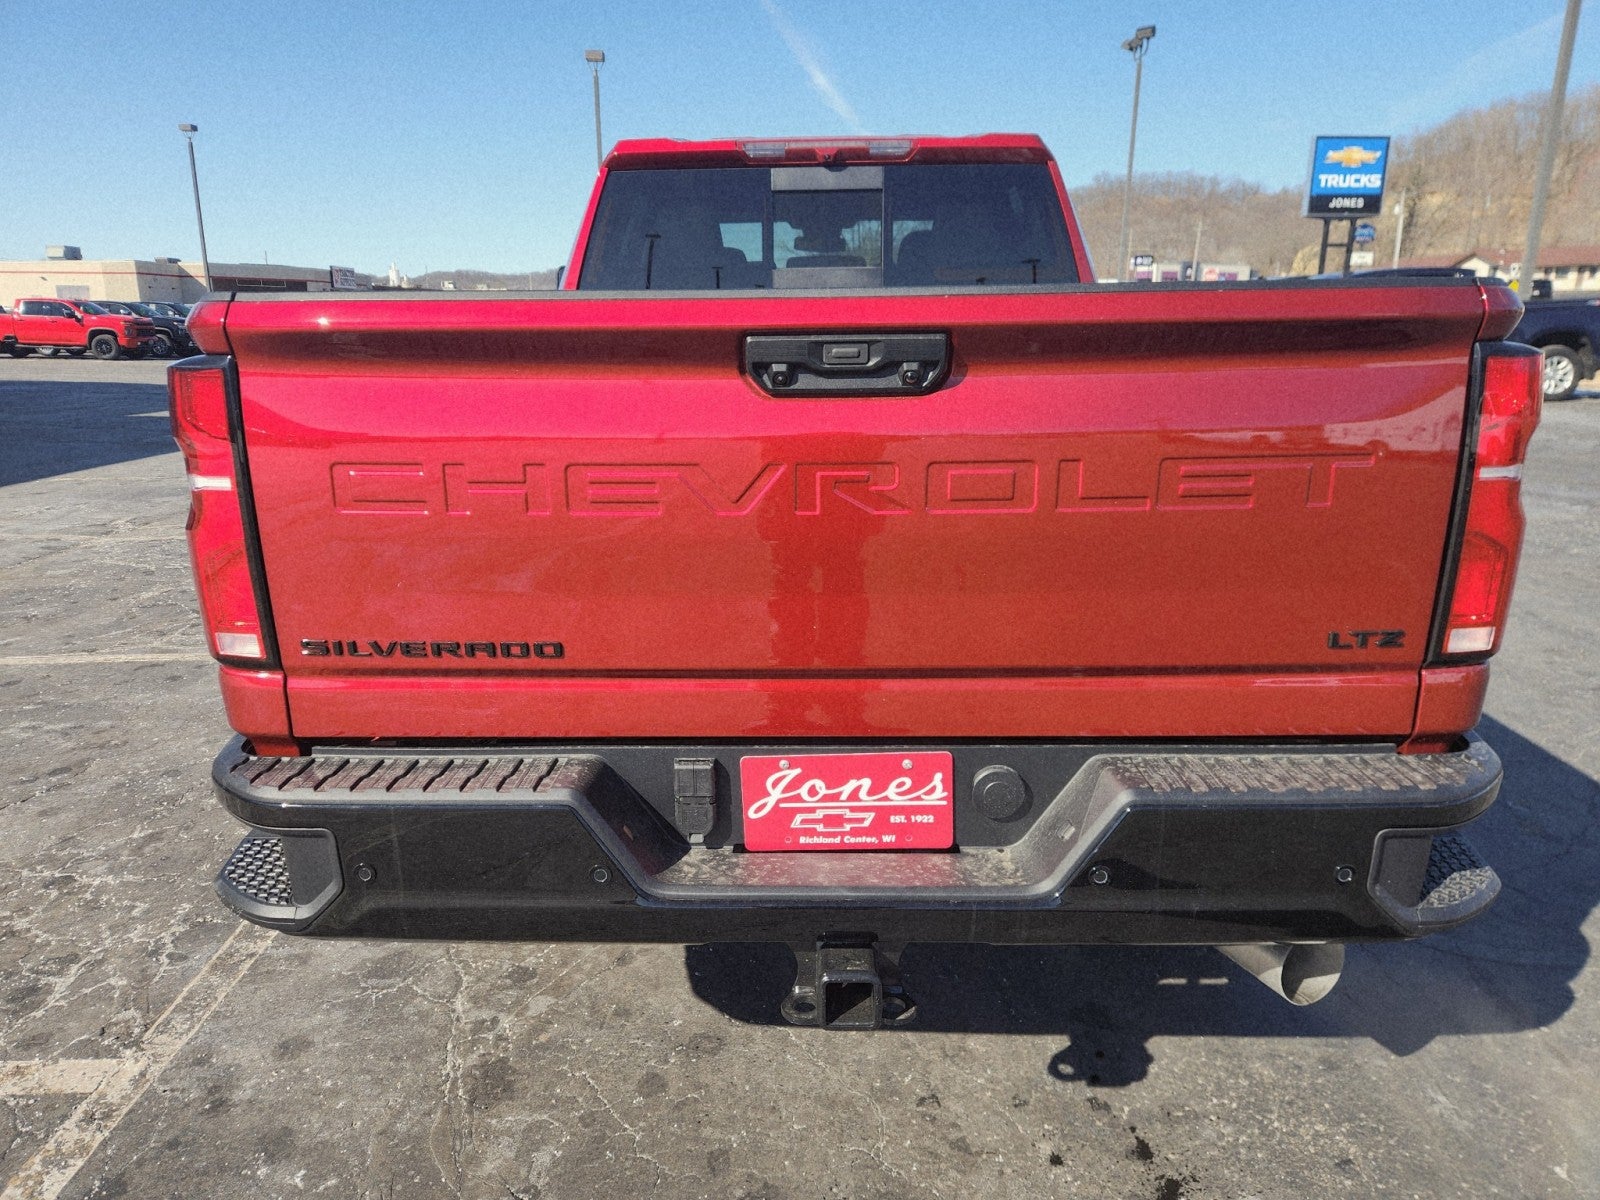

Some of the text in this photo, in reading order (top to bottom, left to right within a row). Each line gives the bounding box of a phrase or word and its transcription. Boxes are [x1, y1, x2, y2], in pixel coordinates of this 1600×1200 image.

[1319, 173, 1382, 188] TRUCKS
[1328, 197, 1364, 208] JONES
[330, 453, 1375, 516] CHEVROLET
[1327, 630, 1405, 649] LTZ
[301, 638, 565, 659] SILVERADO
[748, 767, 949, 819] Jones
[889, 814, 935, 823] EST. 1922
[799, 835, 896, 844] Richland Center, WI
